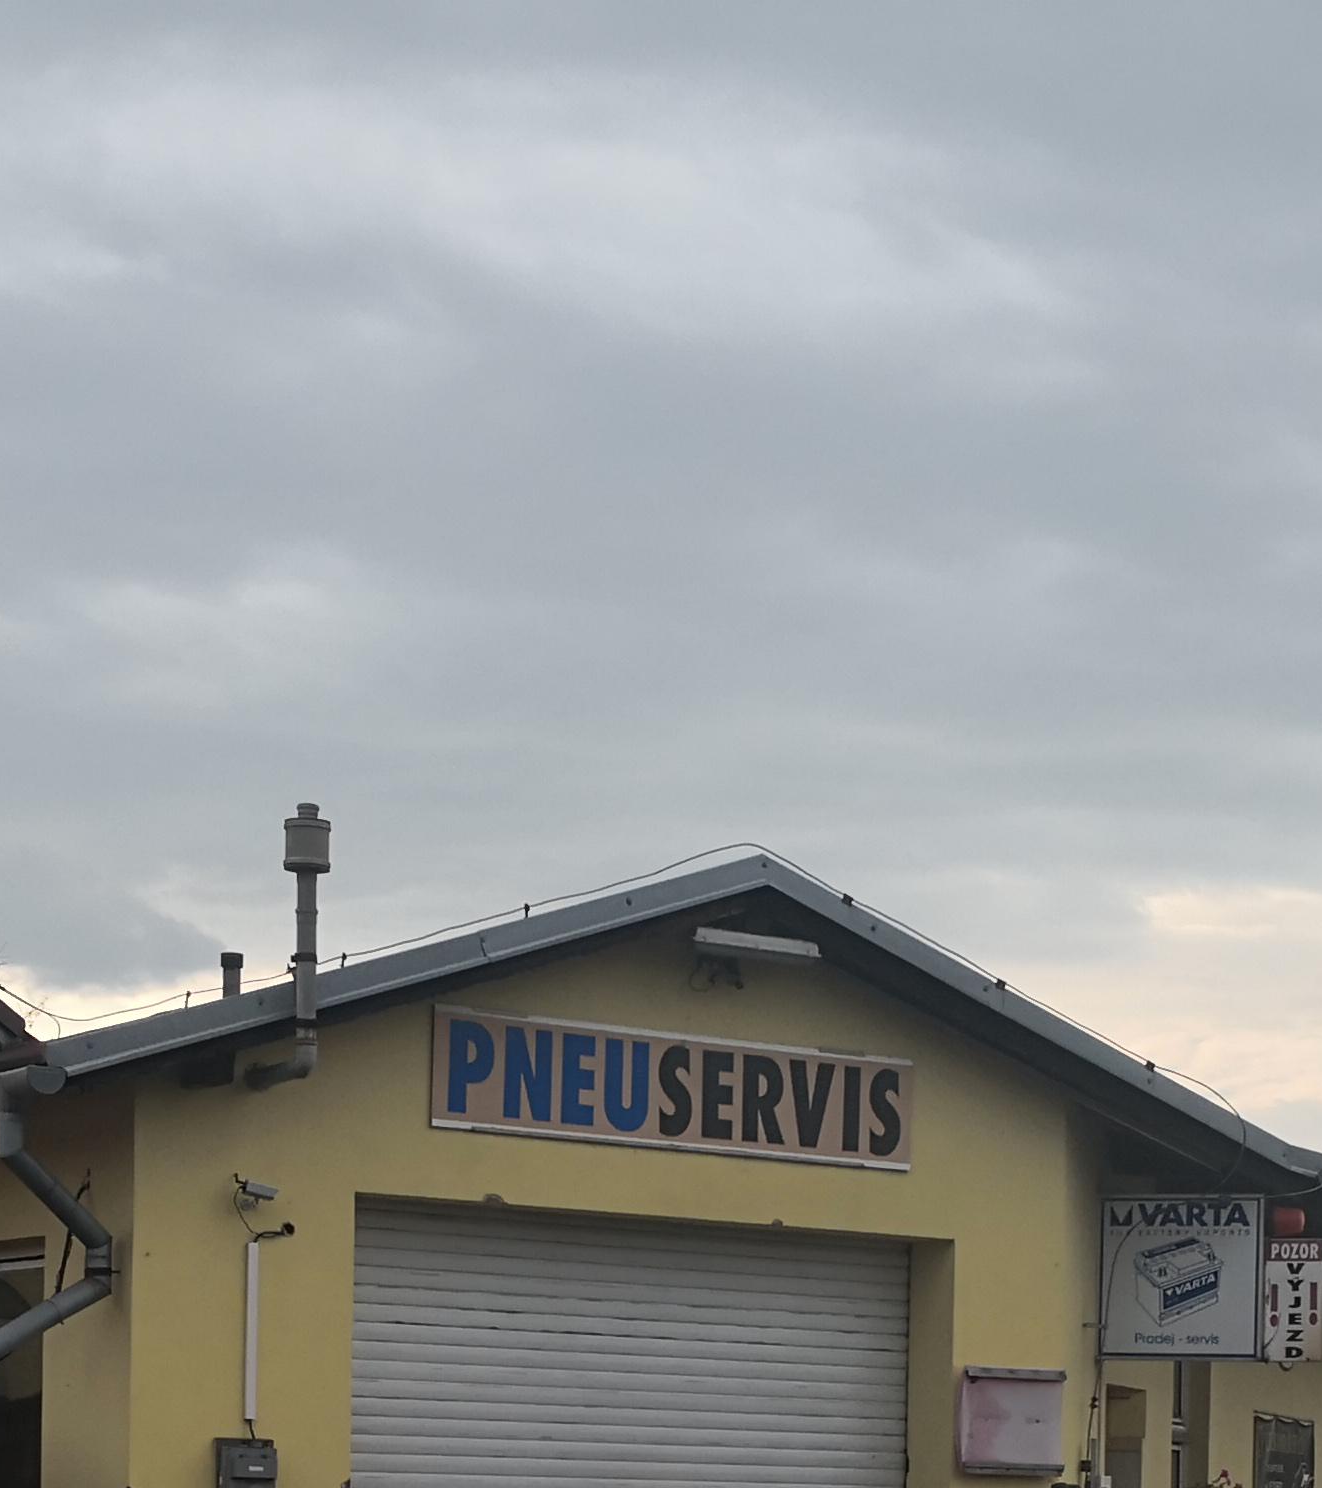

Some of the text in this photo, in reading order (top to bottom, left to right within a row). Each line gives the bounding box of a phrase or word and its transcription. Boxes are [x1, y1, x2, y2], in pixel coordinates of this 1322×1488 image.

[447, 1018, 901, 1156] PNEUSERVIS
[1138, 1202, 1251, 1227] VARTA
[1271, 1242, 1319, 1259] POZOR
[1174, 1274, 1215, 1295] VARTA
[1134, 1332, 1175, 1346] Prodej
[1186, 1332, 1220, 1345] servis
